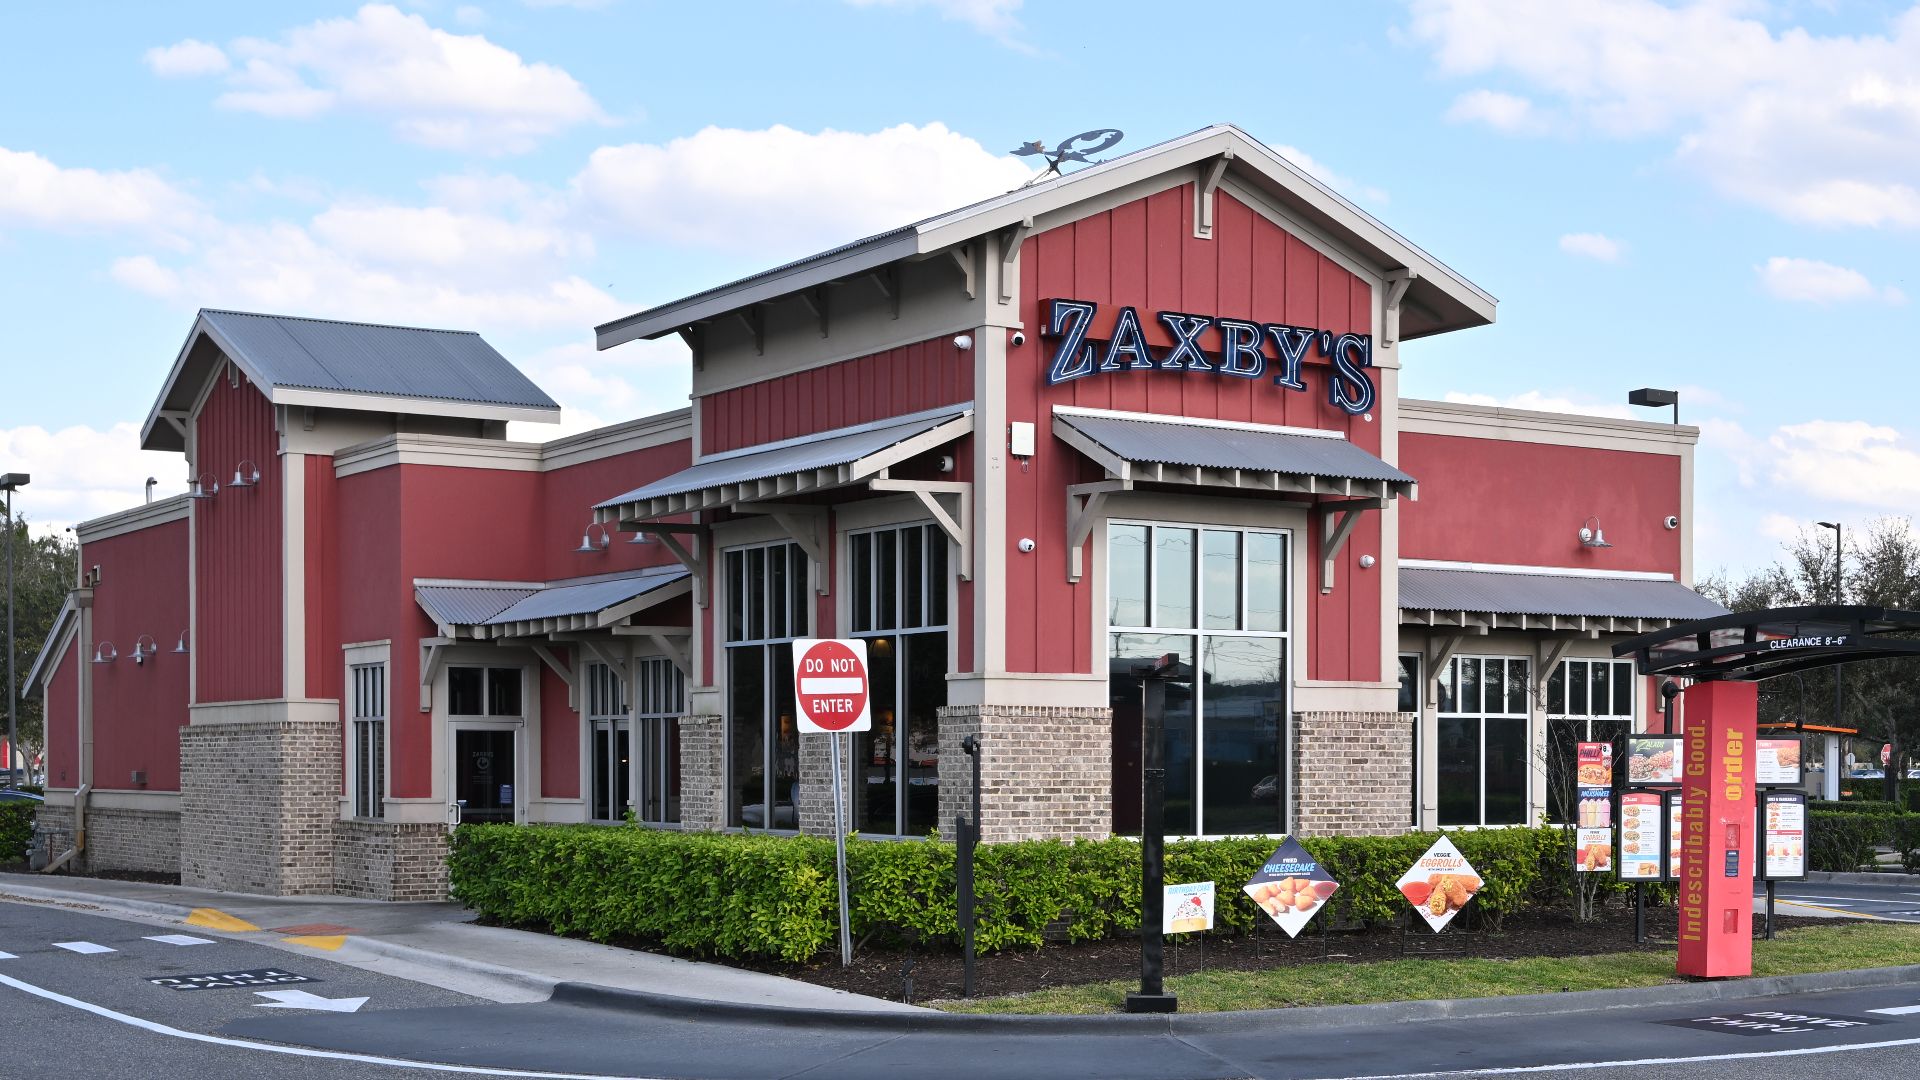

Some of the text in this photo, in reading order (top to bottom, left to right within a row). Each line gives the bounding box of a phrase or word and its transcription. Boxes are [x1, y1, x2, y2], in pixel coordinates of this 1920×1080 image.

[1047, 298, 1376, 416] ZAXBY'S
[1770, 637, 1821, 649] CLEARANCE
[805, 658, 855, 673] DO NOT
[812, 699, 853, 714] ENTER
[1723, 728, 1744, 801] order
[1682, 719, 1707, 941] Indescribably Good.
[1263, 863, 1316, 874] CHEESECAKE
[1420, 858, 1464, 868] EGGROLLS
[1691, 1016, 1815, 1033] THRU
[1742, 1011, 1870, 1028] DRIVE
